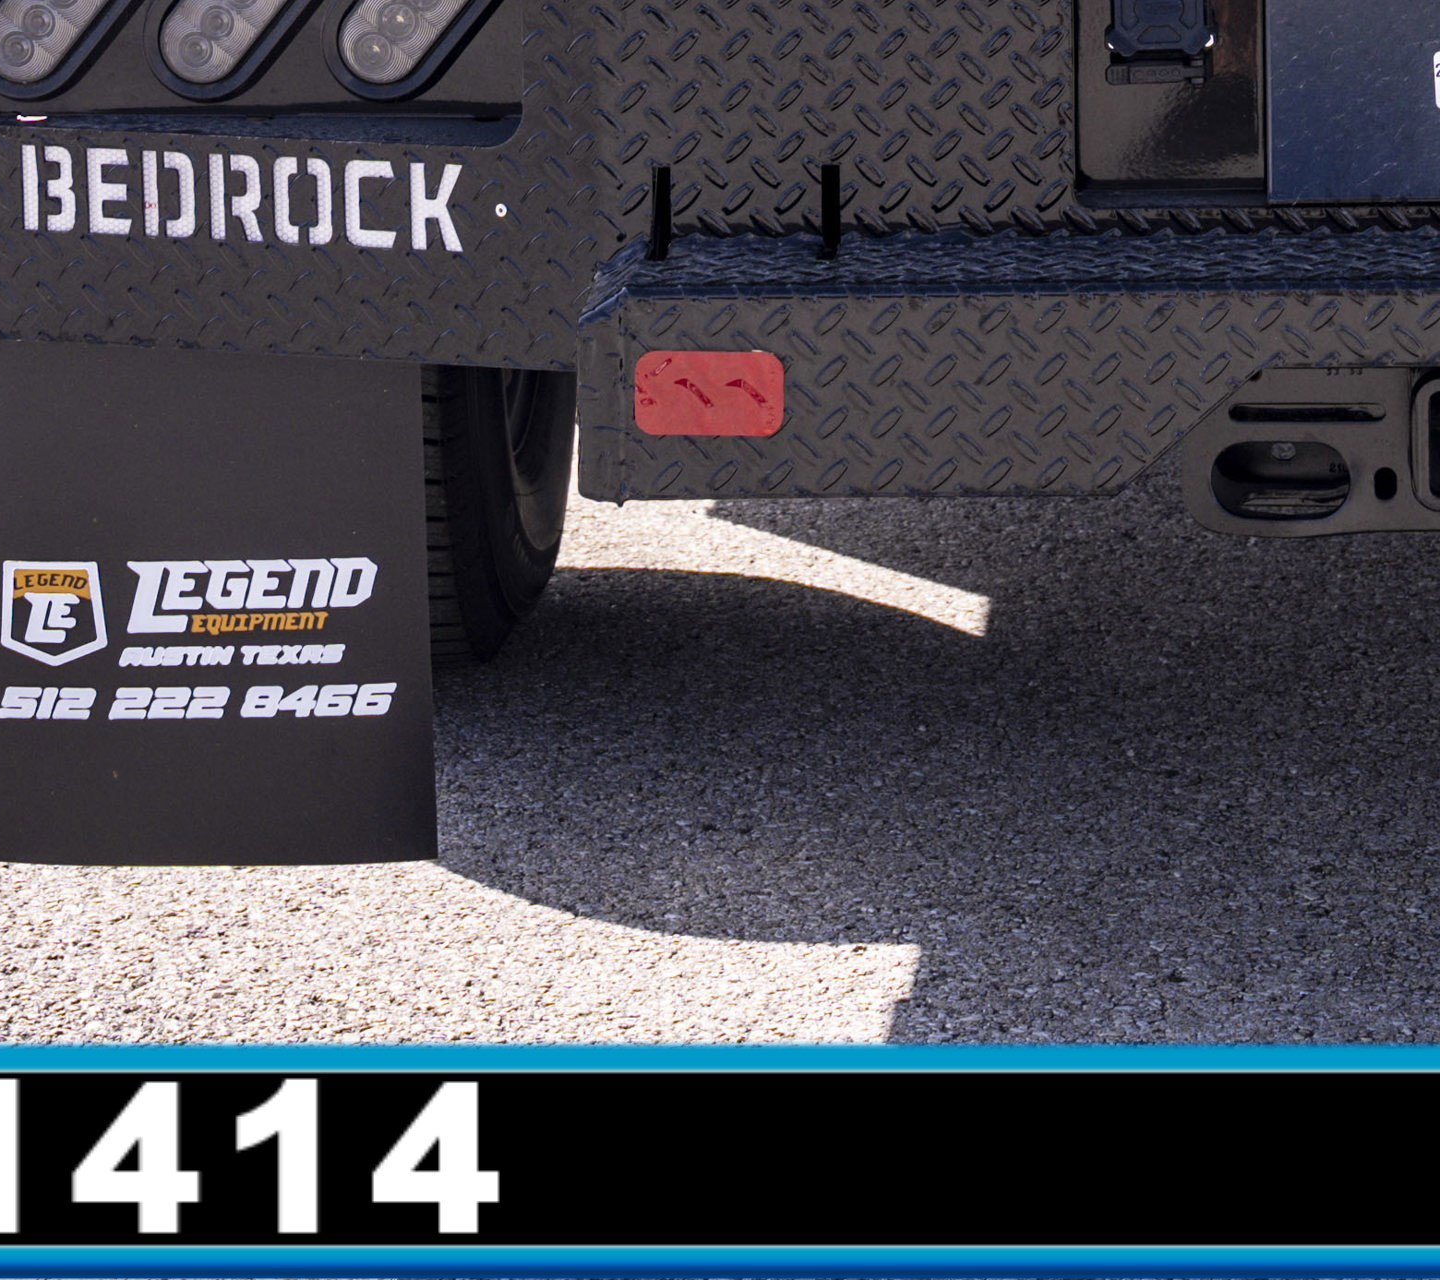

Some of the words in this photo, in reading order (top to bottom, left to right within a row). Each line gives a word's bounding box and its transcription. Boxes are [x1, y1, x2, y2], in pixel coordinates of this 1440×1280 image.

[21, 144, 463, 252] BEDROCK
[14, 572, 89, 591] LEGEND
[126, 557, 378, 634] LEGEND
[190, 611, 329, 635] EQUIPMENT
[118, 646, 235, 667] AUSTIN
[240, 644, 346, 666] TEXAS
[108, 686, 231, 720] 222
[240, 682, 397, 718] 8466
